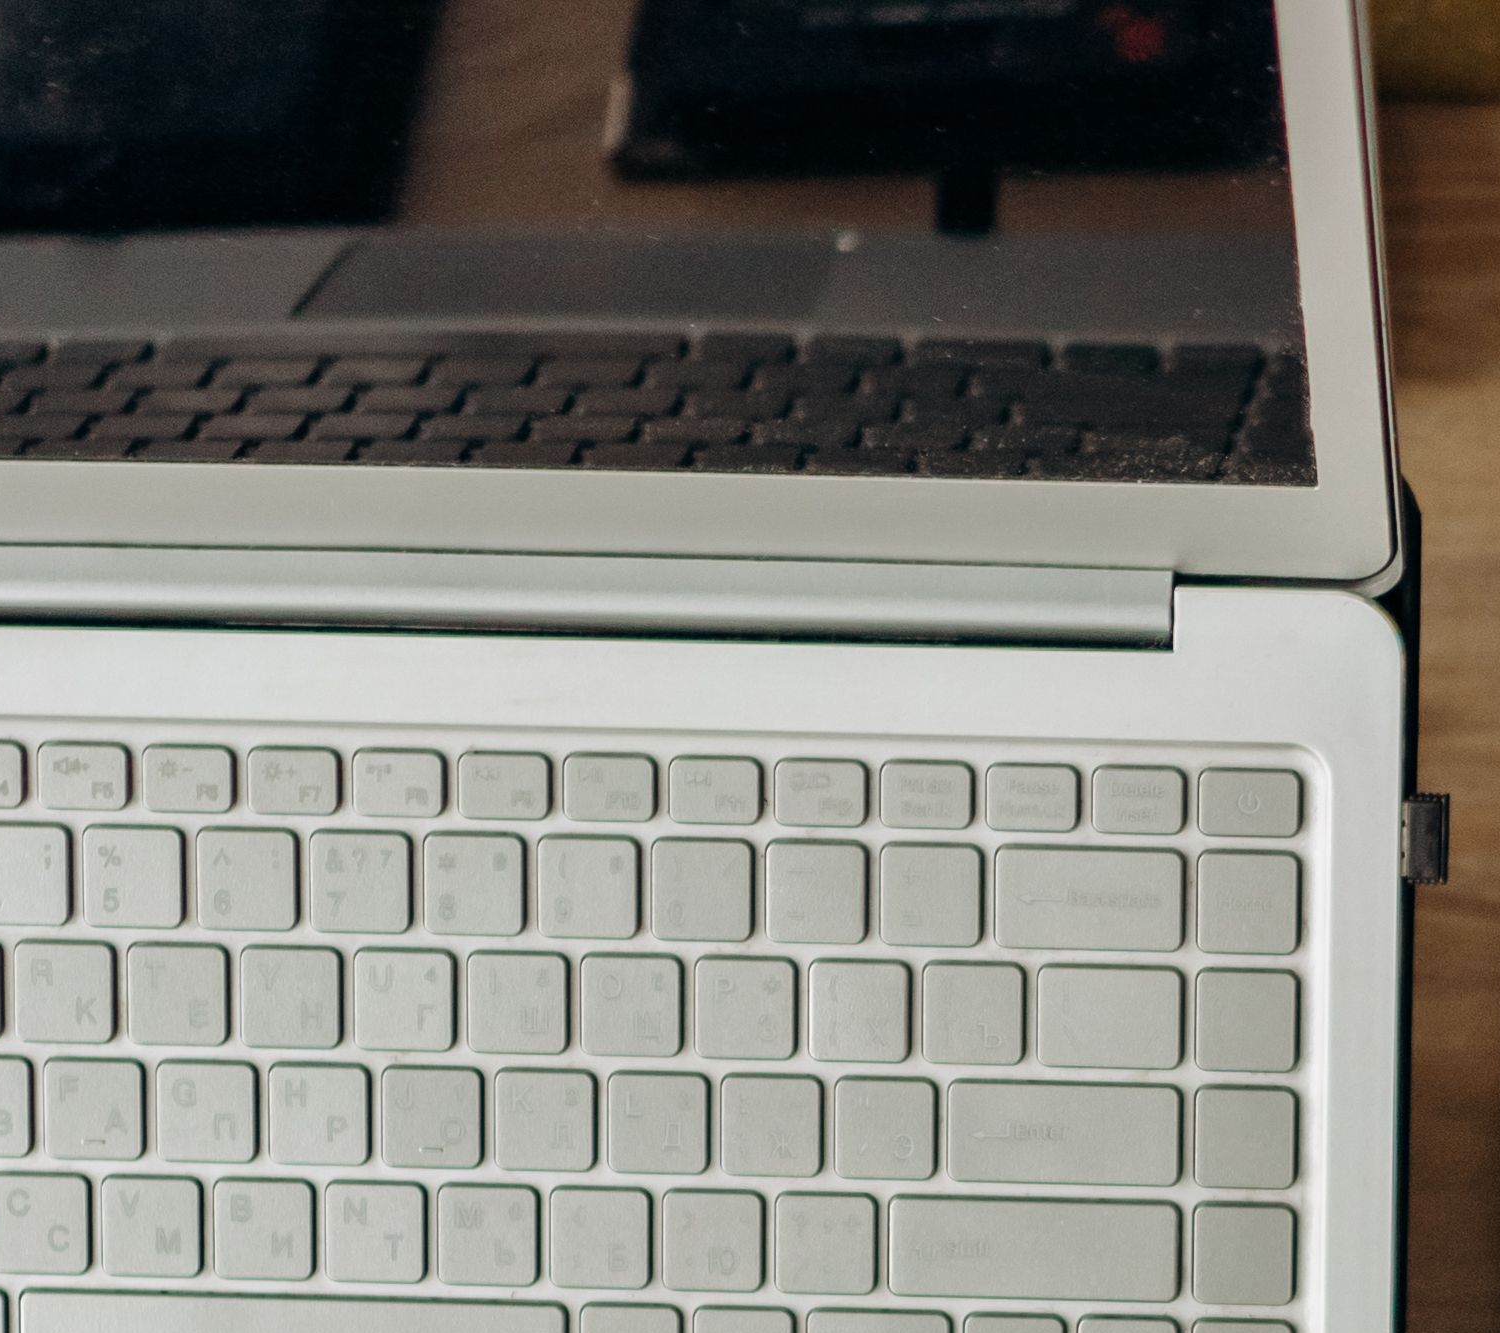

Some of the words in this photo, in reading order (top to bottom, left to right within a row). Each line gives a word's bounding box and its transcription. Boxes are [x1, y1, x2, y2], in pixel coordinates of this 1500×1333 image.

[90, 780, 114, 800] F5
[195, 783, 219, 802] F6
[298, 784, 322, 804] F7
[97, 845, 123, 869] %
[102, 887, 121, 914] 5
[212, 888, 233, 916] 6
[324, 890, 347, 919] 7
[29, 957, 55, 987] R
[143, 961, 168, 991] T
[256, 962, 281, 992] Y
[366, 963, 394, 994] U
[57, 1074, 81, 1103] F
[170, 1076, 198, 1108] G
[283, 1078, 308, 1108] H
[624, 1089, 644, 1119] L
[212, 1112, 237, 1141] П
[5, 1187, 32, 1218] C
[118, 1189, 142, 1220] V
[229, 1192, 254, 1225] B
[342, 1196, 369, 1227] N
[453, 1200, 485, 1231] M
